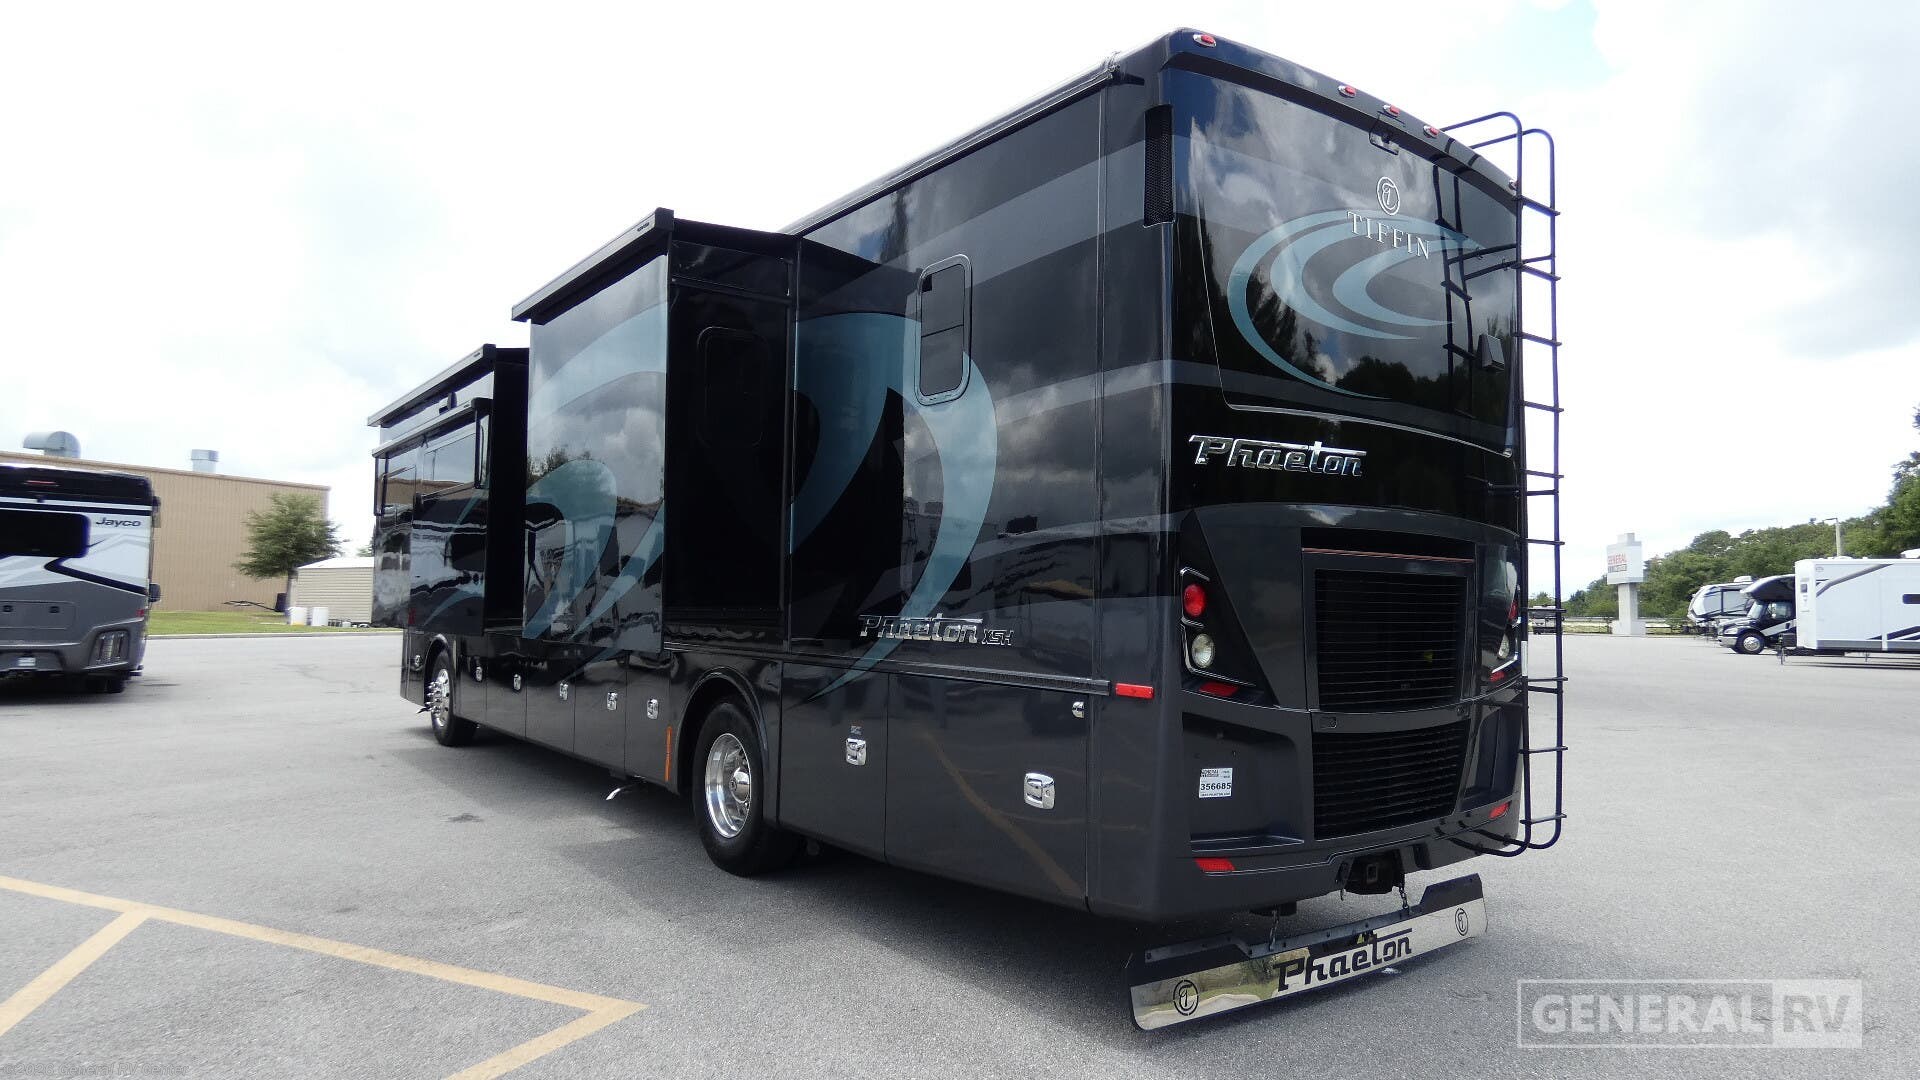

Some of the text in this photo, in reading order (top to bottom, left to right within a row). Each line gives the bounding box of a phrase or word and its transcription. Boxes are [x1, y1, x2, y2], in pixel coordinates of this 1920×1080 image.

[1347, 211, 1430, 260] TIFFIN
[1189, 434, 1367, 477] Phaeton
[96, 517, 141, 528] Jayco
[858, 613, 983, 644] Phaeton
[1200, 782, 1232, 790] 356685
[1273, 928, 1412, 991] Phaeton
